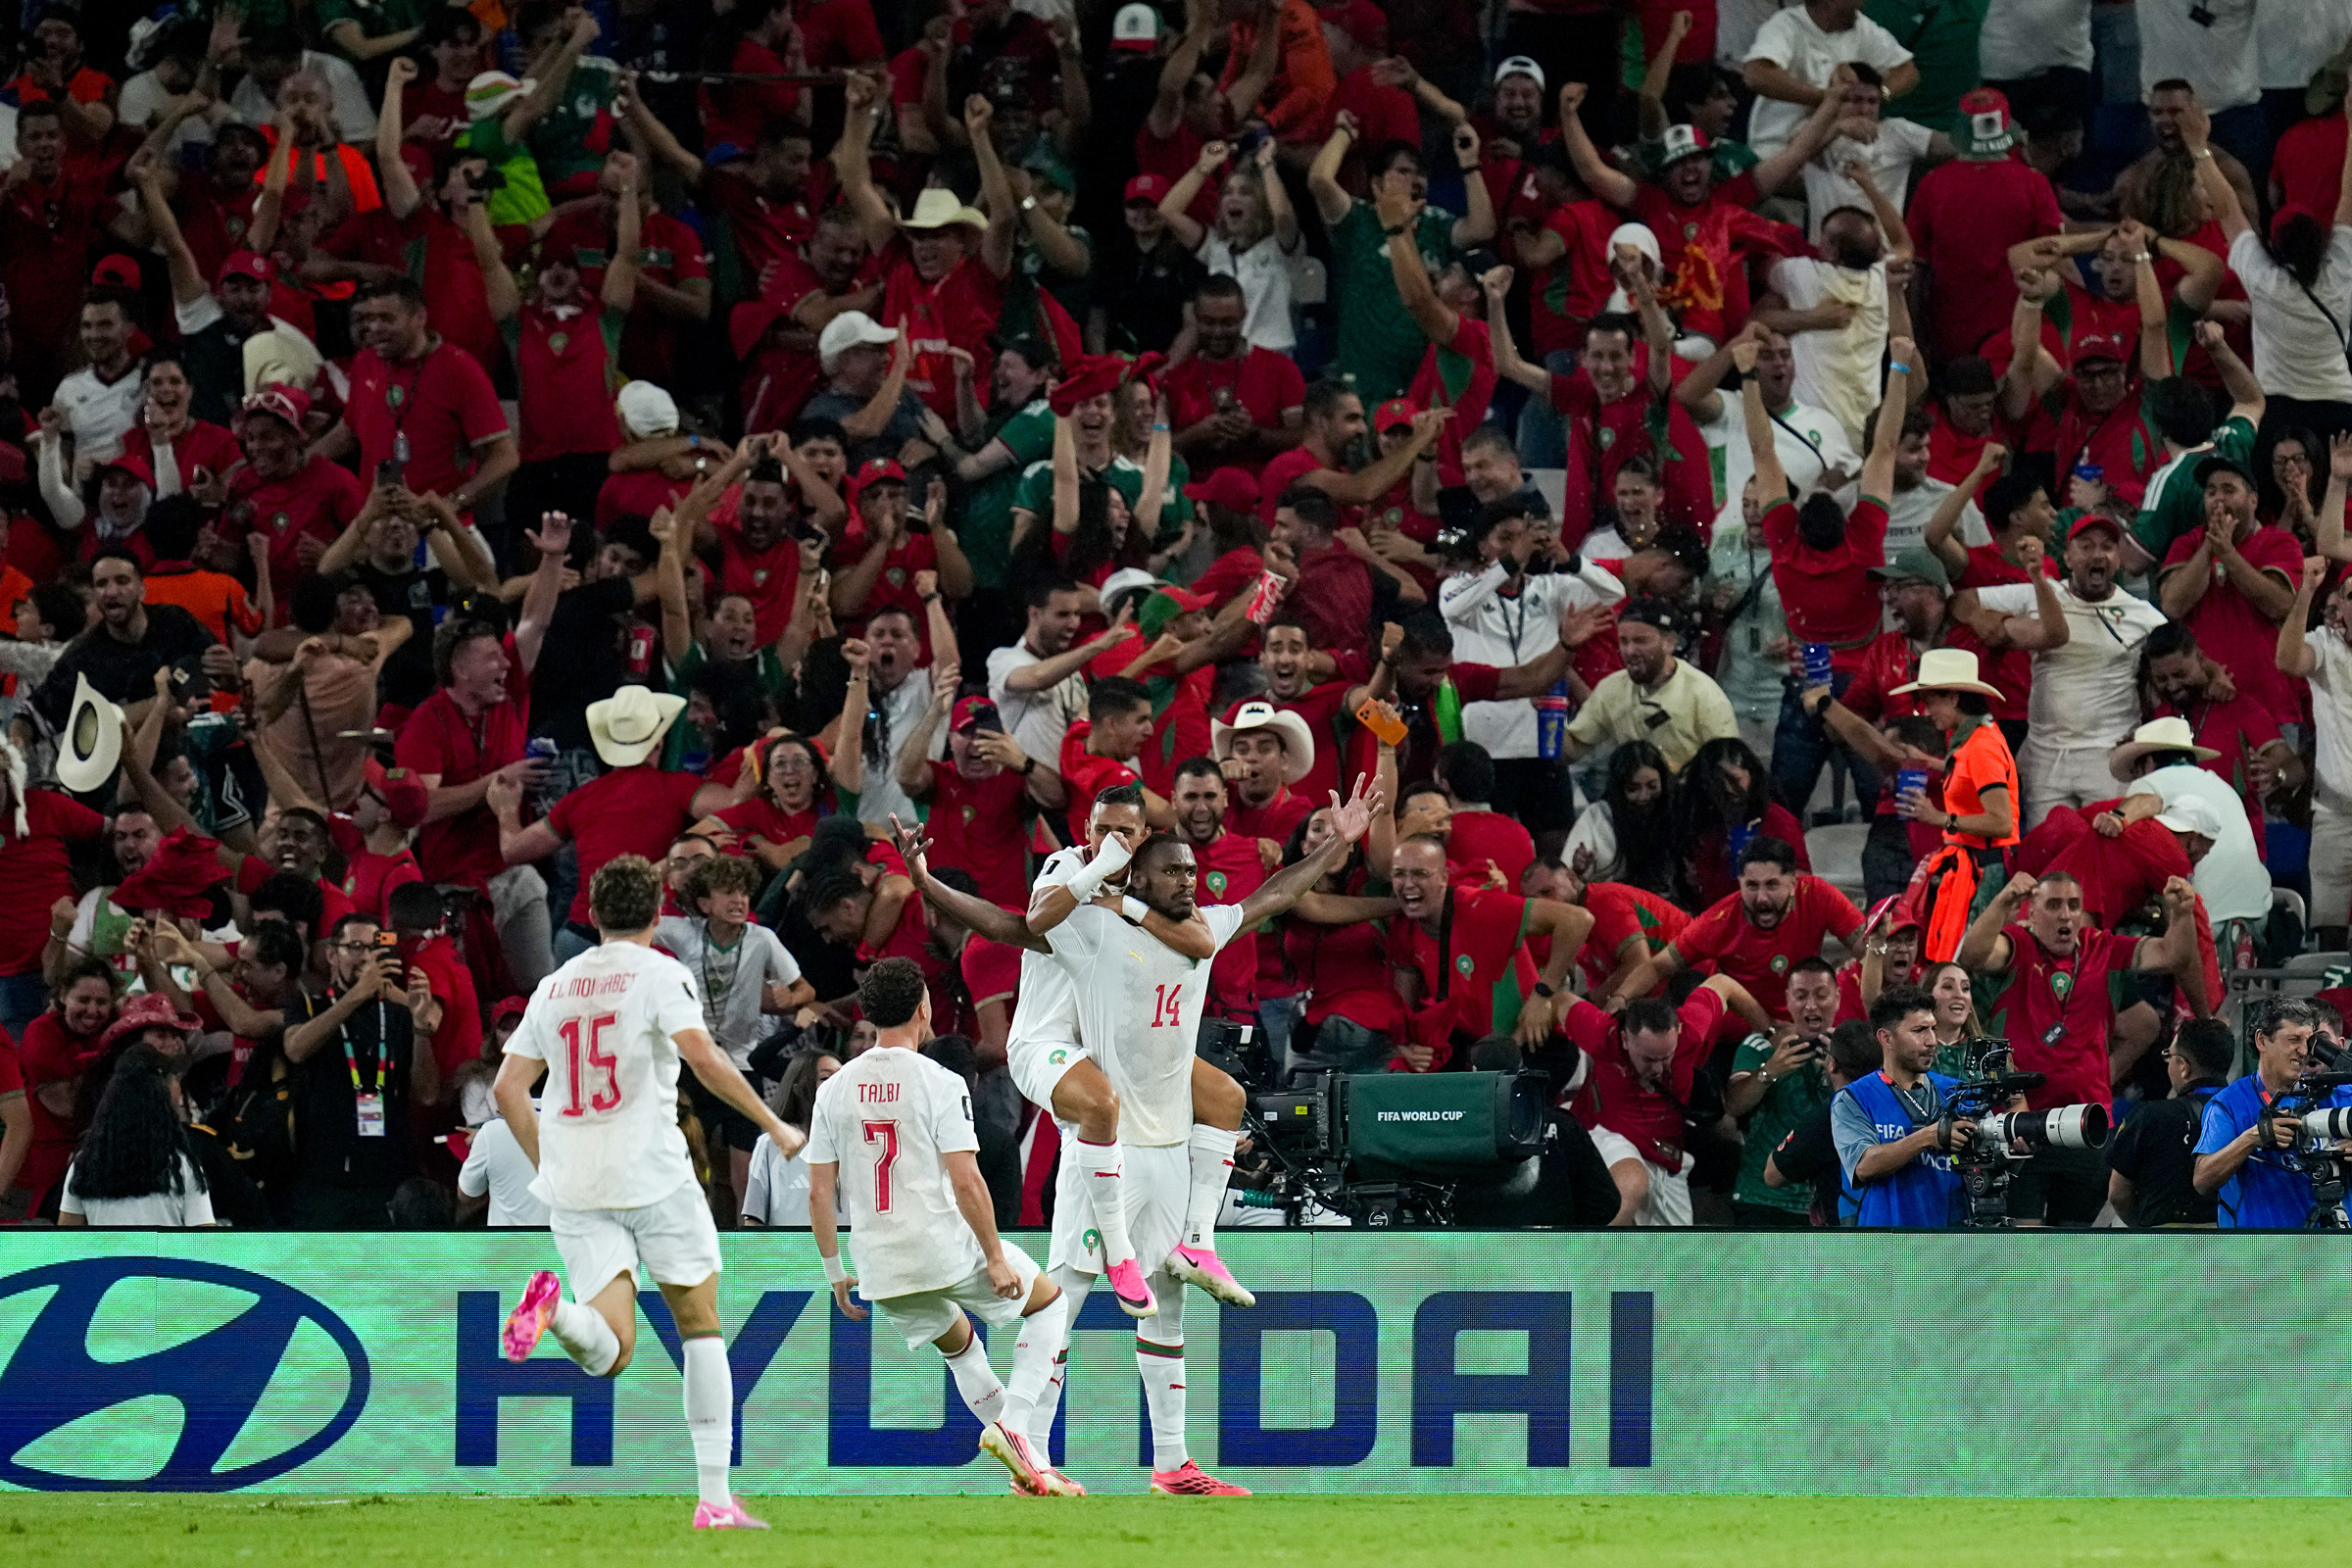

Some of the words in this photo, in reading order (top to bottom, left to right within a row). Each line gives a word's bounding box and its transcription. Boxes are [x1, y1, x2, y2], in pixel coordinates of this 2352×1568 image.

[1151, 984, 1182, 1028] 14
[558, 1010, 623, 1116] 15
[858, 1083, 901, 1103] TALBI
[1377, 1110, 1400, 1121] FIFA
[1401, 1110, 1441, 1121] WORLD
[1876, 1123, 1907, 1140] FIFA
[861, 1119, 902, 1215] 7
